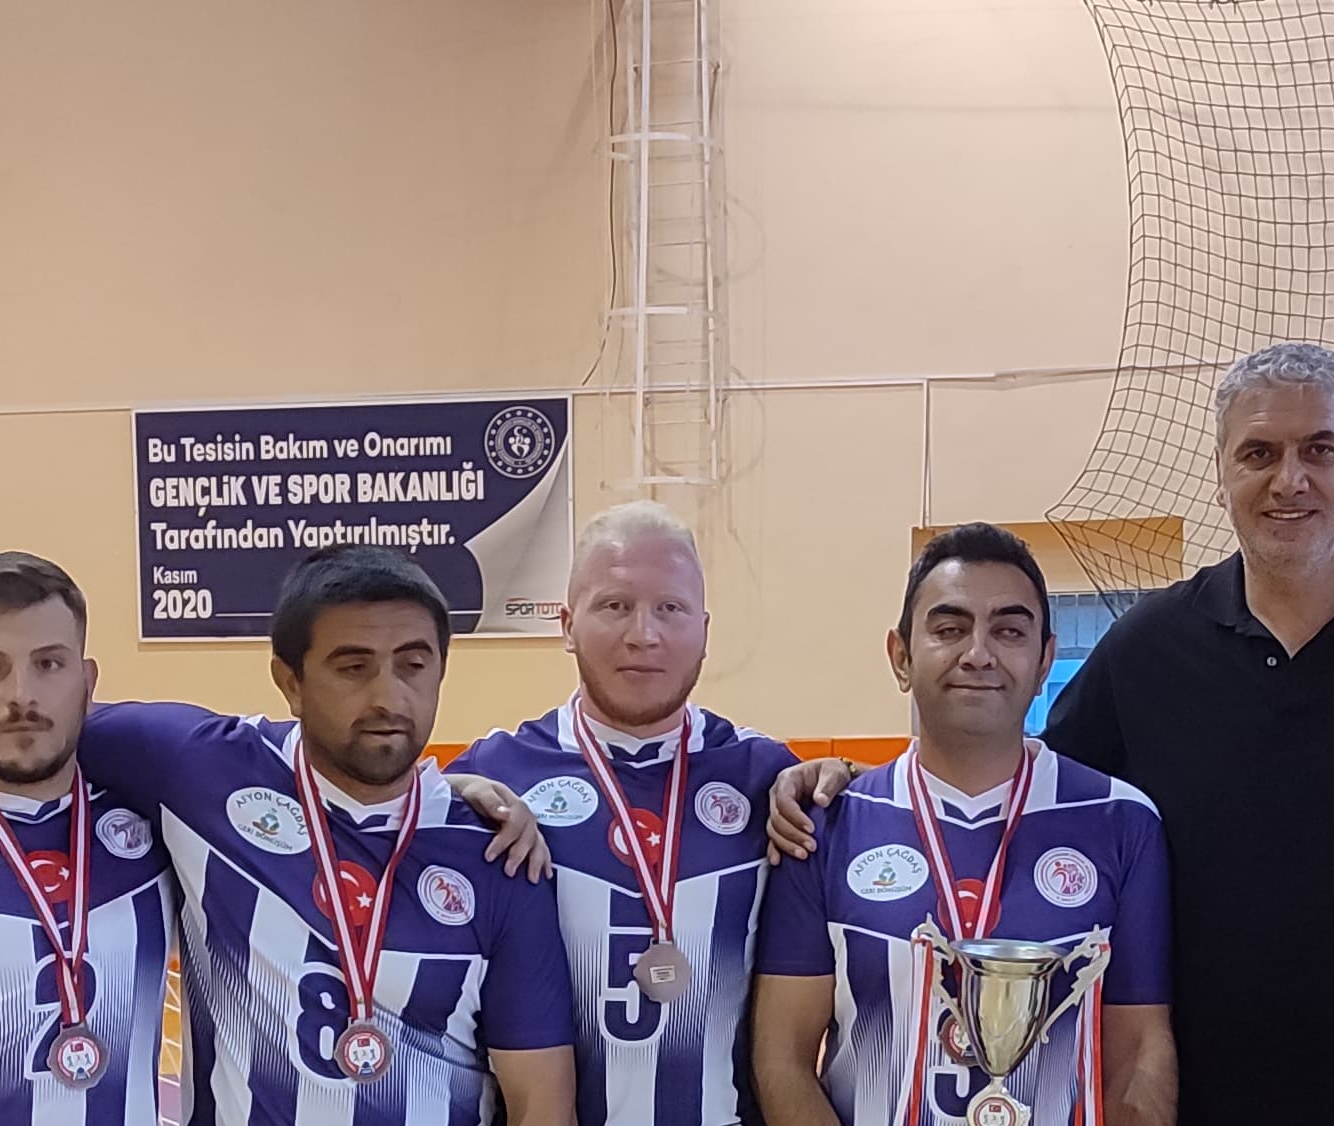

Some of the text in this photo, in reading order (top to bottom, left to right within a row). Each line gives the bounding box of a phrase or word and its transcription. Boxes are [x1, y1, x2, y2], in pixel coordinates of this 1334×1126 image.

[148, 431, 451, 462] Bu Tesisin Bakım ve Onarımı
[251, 475, 283, 505] VE
[287, 474, 351, 504] SPOR
[357, 461, 484, 502] BAKANLIĞI
[150, 517, 455, 553] Tarafından Yaptırılmıştır.
[153, 566, 198, 584] Kasım
[153, 589, 213, 619] 2020
[599, 926, 670, 1044] 5
